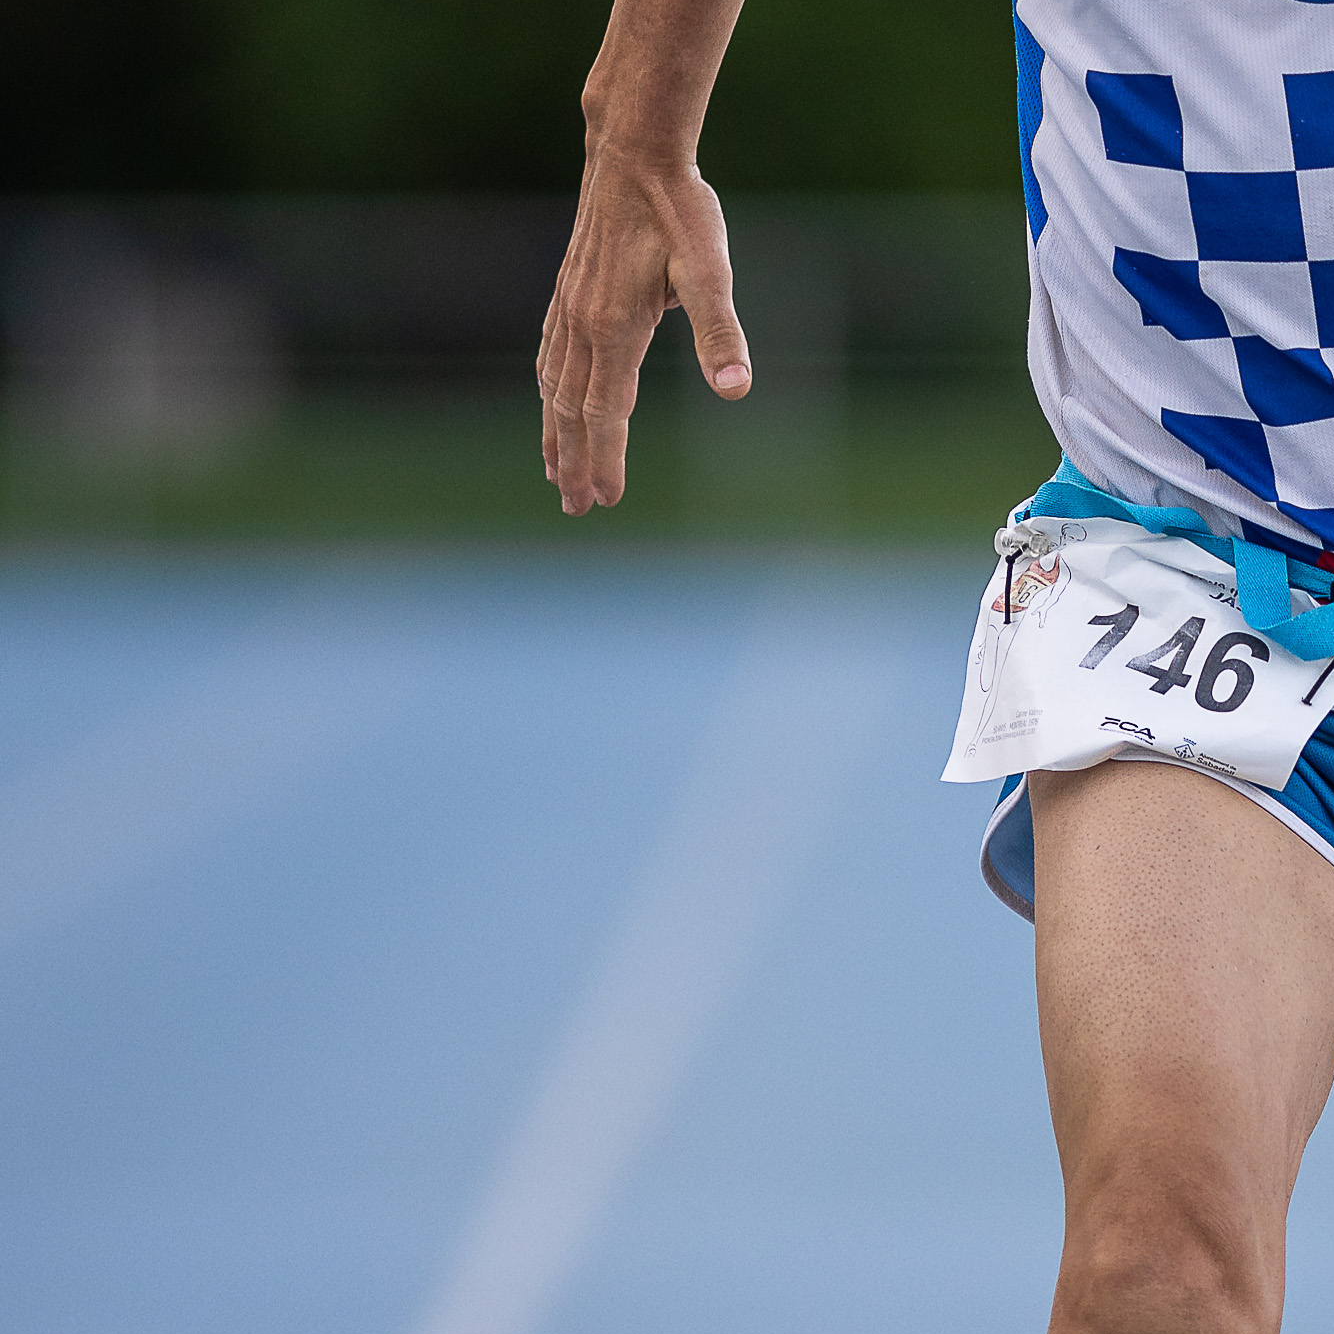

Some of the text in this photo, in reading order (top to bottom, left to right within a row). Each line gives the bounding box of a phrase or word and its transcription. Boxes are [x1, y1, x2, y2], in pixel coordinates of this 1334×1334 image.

[1079, 603, 1270, 713] 146
[1100, 716, 1156, 740] FCA
[1196, 756, 1236, 776] Sabadell
